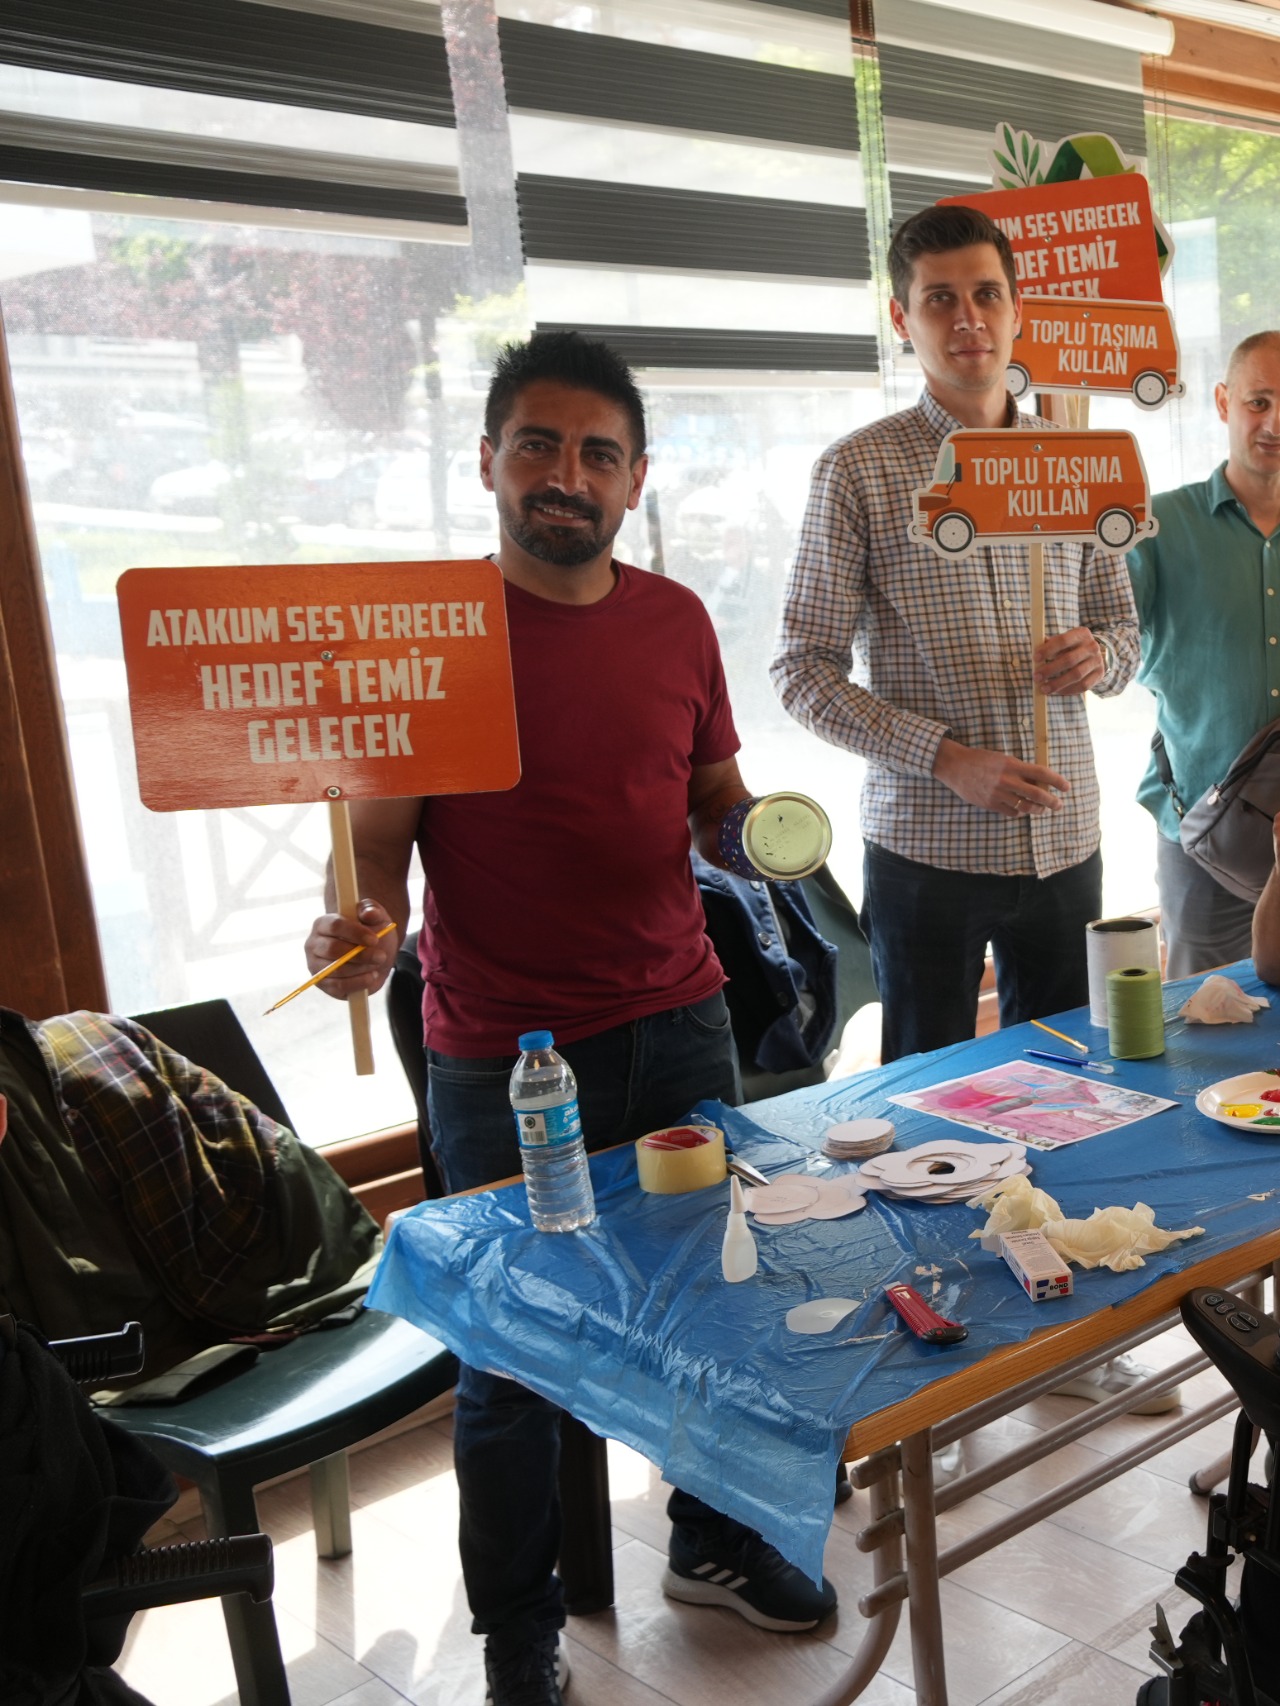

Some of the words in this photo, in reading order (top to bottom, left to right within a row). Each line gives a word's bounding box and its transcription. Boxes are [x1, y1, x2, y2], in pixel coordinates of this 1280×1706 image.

[1024, 212, 1059, 238] SES
[1060, 202, 1141, 233] VERECEK
[1013, 249, 1049, 281] DEF
[1053, 235, 1119, 275] TEMİZ
[1030, 319, 1087, 346] TOPLU
[1091, 322, 1158, 353] TAŞIMA
[1058, 348, 1127, 375] KULLAN
[971, 457, 1038, 485] TOPLU
[1044, 456, 1123, 489] TAŞIMA
[1007, 488, 1088, 517] KULLAN
[146, 608, 280, 647] ATAKUM
[286, 606, 345, 642] SES
[350, 602, 487, 640] VERECEK
[200, 661, 326, 710] HEDEF
[333, 647, 445, 704] TEMİZ
[248, 713, 414, 764] GELECEK
[1049, 1282, 1068, 1291] BOND
